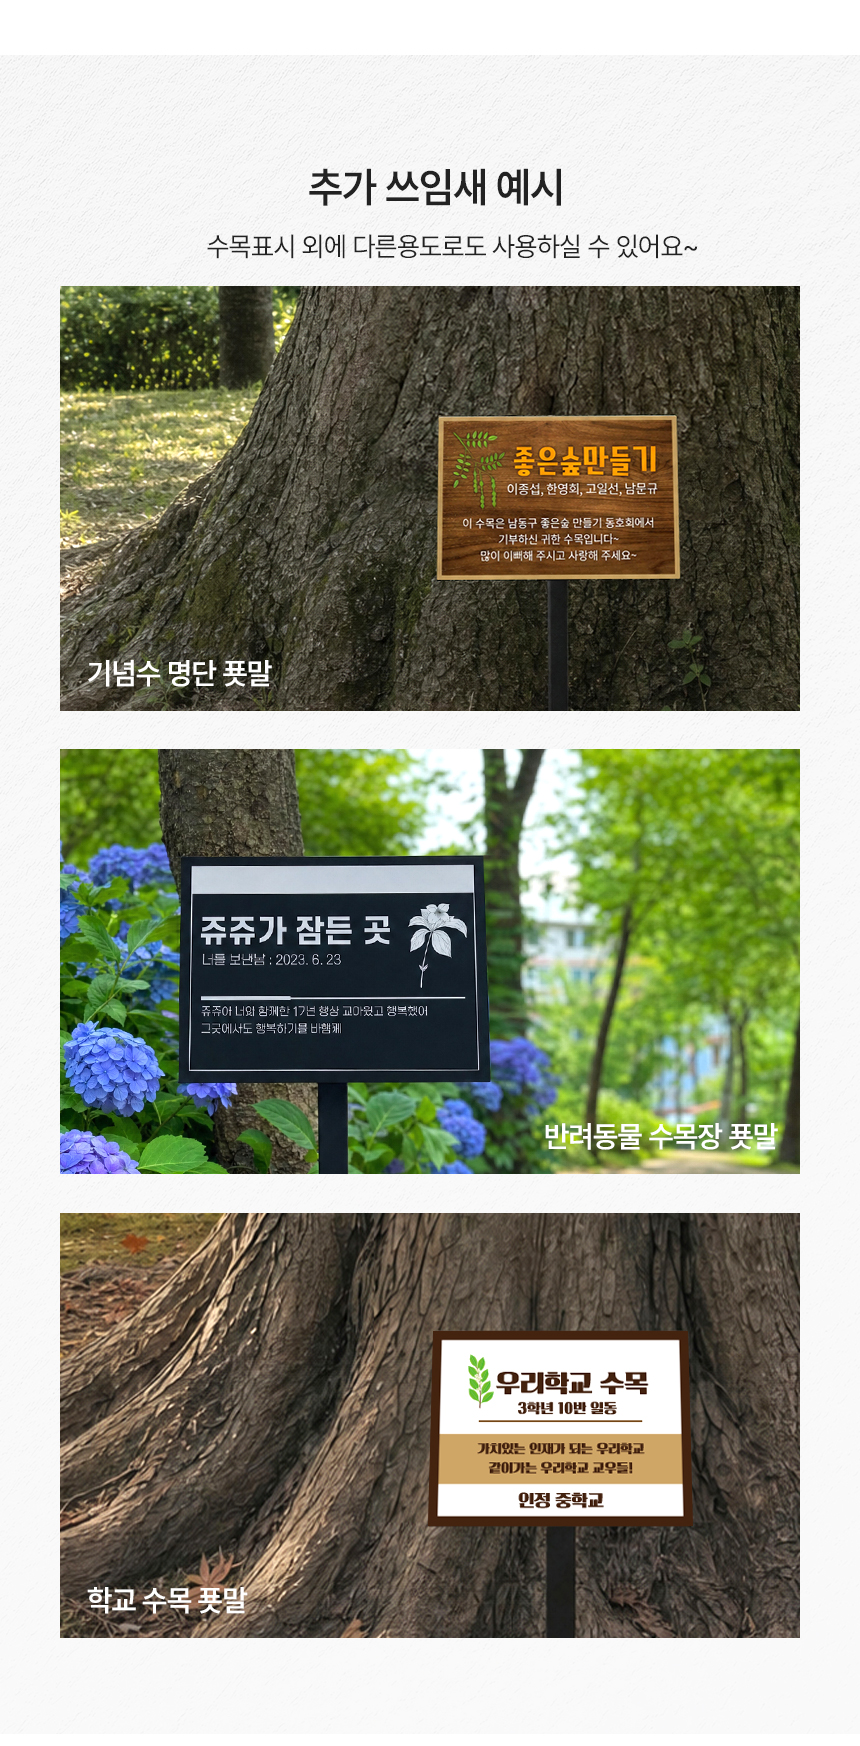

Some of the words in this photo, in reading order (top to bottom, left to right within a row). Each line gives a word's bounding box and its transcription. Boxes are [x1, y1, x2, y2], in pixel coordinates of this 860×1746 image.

[513, 445, 656, 477] 좋은숲만들기
[507, 482, 544, 497] 이종섭,
[546, 482, 583, 497] 한영회,
[585, 482, 623, 497] 고일선,
[624, 482, 658, 495] 남문규
[462, 517, 472, 530] 이
[475, 517, 505, 529] 수목은
[507, 517, 538, 530] 남동구
[540, 517, 570, 529] 좋은숲
[572, 517, 602, 529] 만들기
[605, 517, 654, 529] 동호회에서
[498, 533, 538, 545] 기부하신
[541, 533, 561, 545] 귀한
[563, 533, 619, 545] 수목입니다~
[480, 550, 500, 562] 많이
[536, 550, 565, 562] 주시고
[568, 549, 598, 562] 사랑해
[601, 549, 637, 561] 주세요~
[200, 916, 288, 946] 쥬쥬가
[296, 915, 353, 946] 잠든
[363, 915, 391, 945] 곳
[275, 953, 309, 966] 2023.
[312, 953, 323, 966] 6.
[326, 953, 342, 965] 23
[293, 1005, 316, 1017] 17년
[496, 1371, 593, 1395] 우리학교
[600, 1371, 649, 1395] 수목
[517, 1401, 554, 1415] 3학년
[557, 1401, 587, 1415] 10반
[590, 1401, 617, 1415] 일동
[477, 1442, 526, 1455] 가치있는
[568, 1442, 593, 1455] 되는
[596, 1442, 645, 1455] 우리학교
[488, 1461, 537, 1474] 같이가는
[540, 1461, 589, 1475] 우리학교
[592, 1461, 633, 1475] 교우들!
[518, 1492, 551, 1509] 인정
[555, 1492, 604, 1509] 중학교
